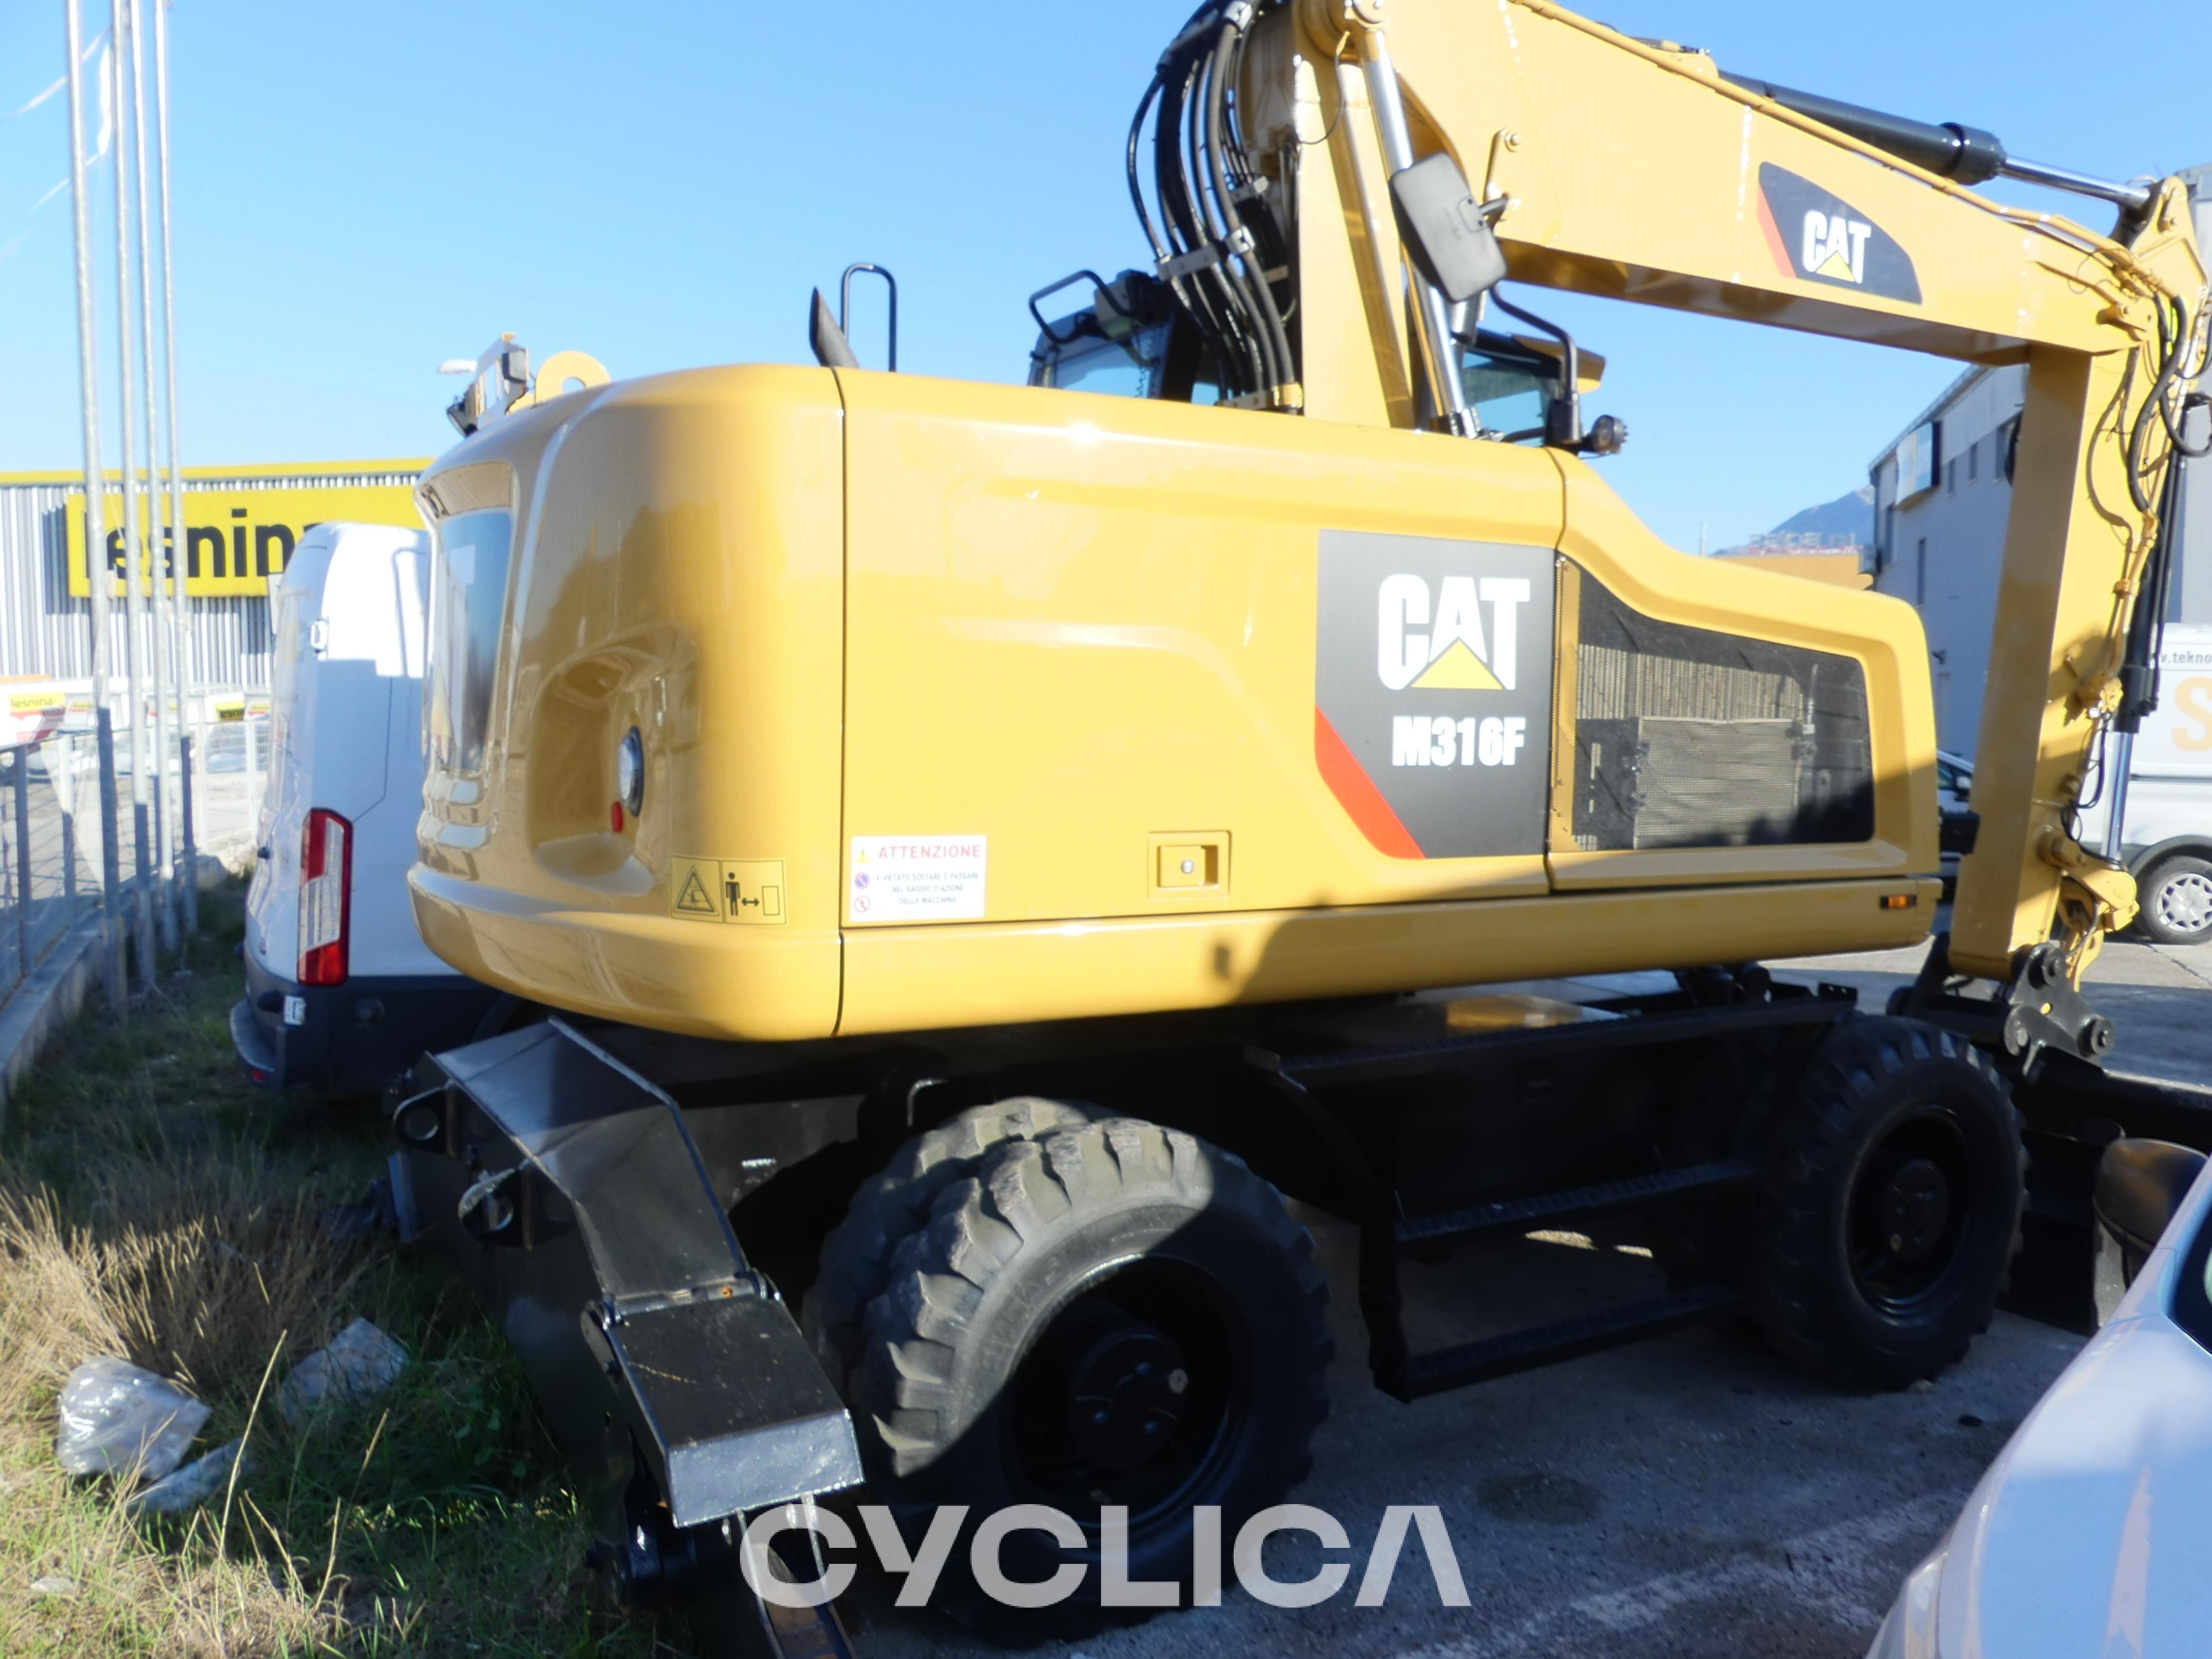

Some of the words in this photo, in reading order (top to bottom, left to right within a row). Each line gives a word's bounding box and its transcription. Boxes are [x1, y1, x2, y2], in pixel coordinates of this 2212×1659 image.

[1802, 210, 1872, 284] CAT
[1378, 573, 1531, 690] CAT
[11, 697, 54, 708] lesnina
[1392, 716, 1526, 766] M316F
[878, 844, 981, 859] ATTENZIONE
[883, 873, 910, 881] VIETATO
[912, 873, 941, 881] SOSTARE
[950, 872, 979, 880] PASSARE
[906, 884, 932, 893] RAGGIO
[898, 896, 919, 905] DELLA
[921, 896, 957, 904] MACCHINA
